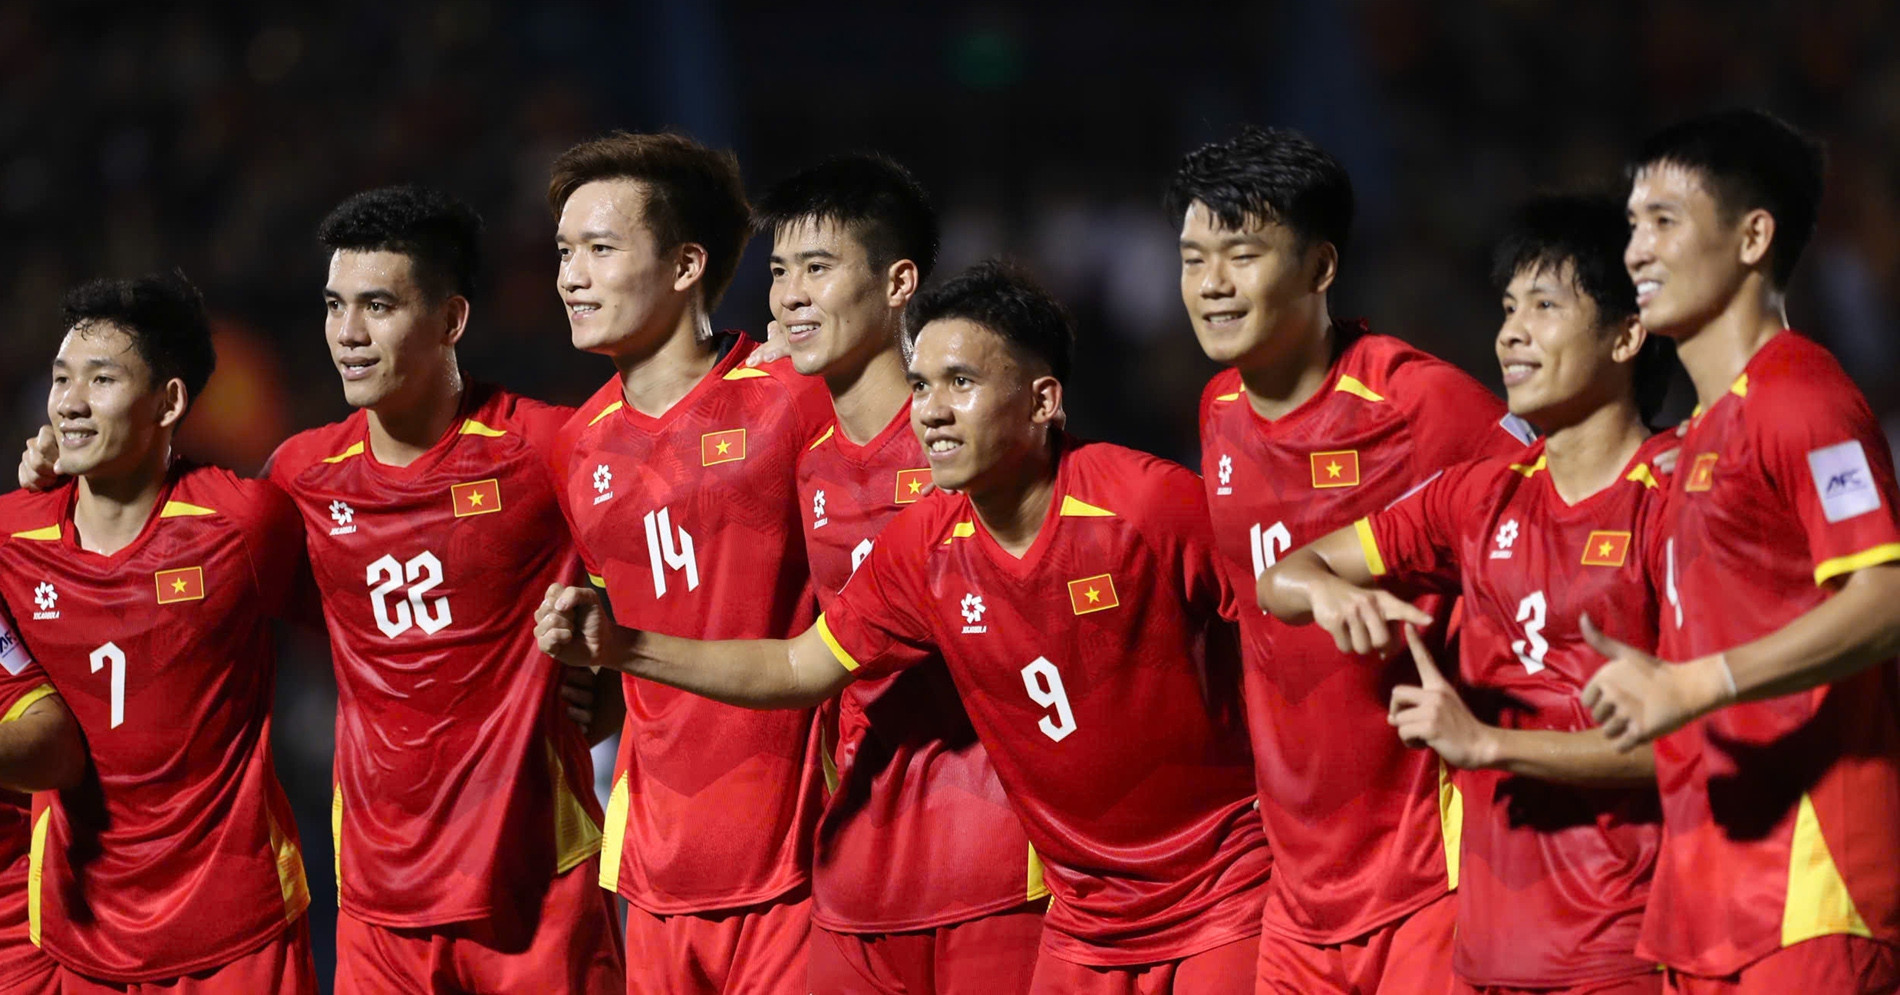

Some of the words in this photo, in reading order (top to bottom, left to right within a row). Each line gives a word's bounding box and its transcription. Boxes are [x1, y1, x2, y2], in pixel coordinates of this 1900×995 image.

[366, 550, 453, 640] 22
[644, 506, 700, 600] 14
[1511, 589, 1549, 676] 3
[89, 641, 126, 729] 7
[1020, 655, 1077, 743] 9
